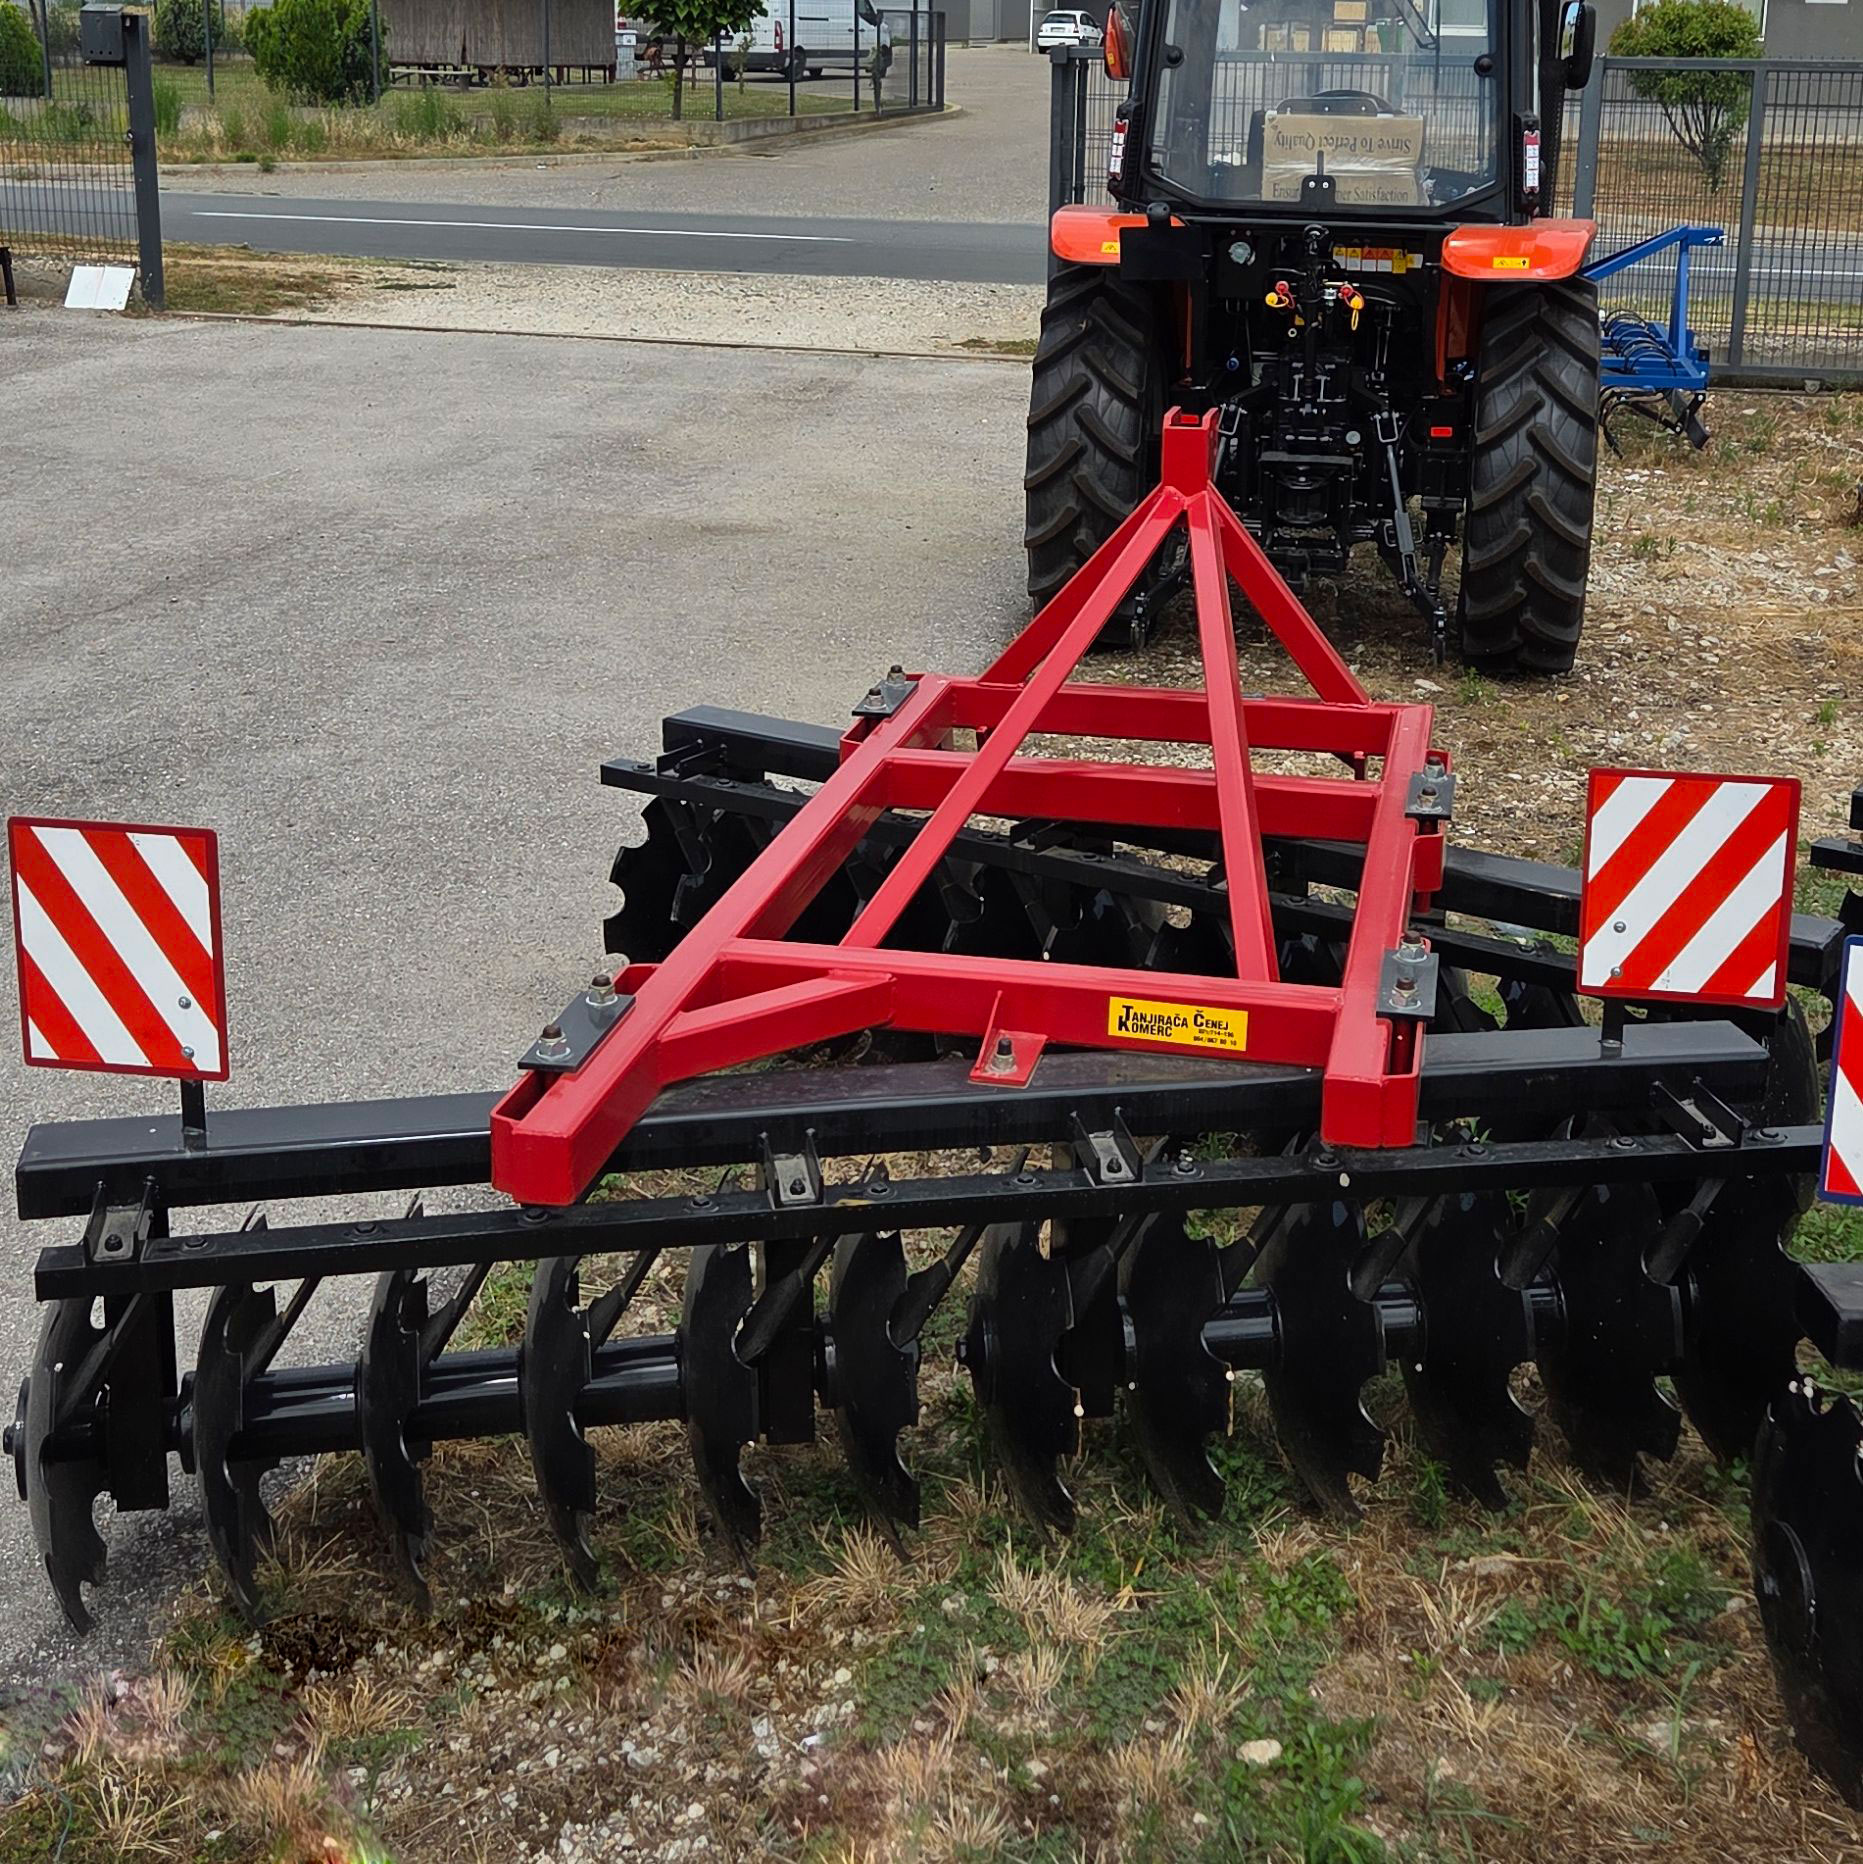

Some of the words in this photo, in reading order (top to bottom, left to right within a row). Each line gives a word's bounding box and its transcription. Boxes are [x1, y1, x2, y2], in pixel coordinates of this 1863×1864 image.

[1274, 131, 1315, 151] Quality
[1319, 136, 1357, 152] Perfect
[1360, 137, 1374, 153] To
[1378, 138, 1411, 154] Strive
[1272, 182, 1300, 198] Ensur
[1354, 185, 1408, 203] Satisfaction
[1118, 1015, 1173, 1037] KOMERC
[1193, 1009, 1229, 1030] ČENEJ
